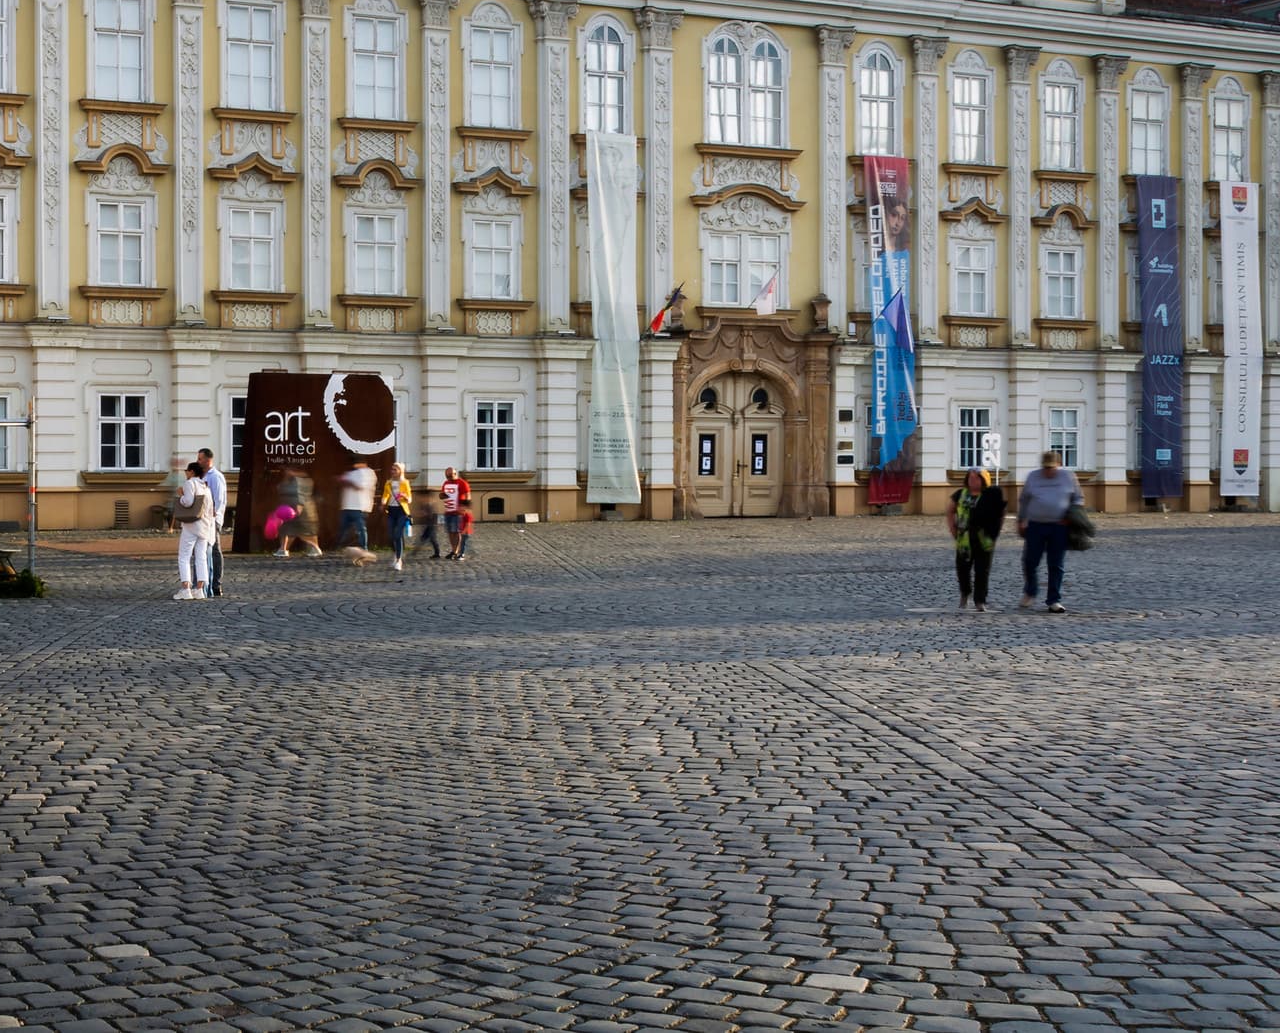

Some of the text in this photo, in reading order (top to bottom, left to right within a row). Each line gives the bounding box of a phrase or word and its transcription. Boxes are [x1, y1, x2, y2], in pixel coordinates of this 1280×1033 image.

[870, 205, 887, 435] BAROQUE RELOADED
[1150, 355, 1180, 365] JAZZx
[1238, 358, 1248, 433] CONSILIUL
[264, 405, 312, 442] art
[264, 441, 316, 455] united
